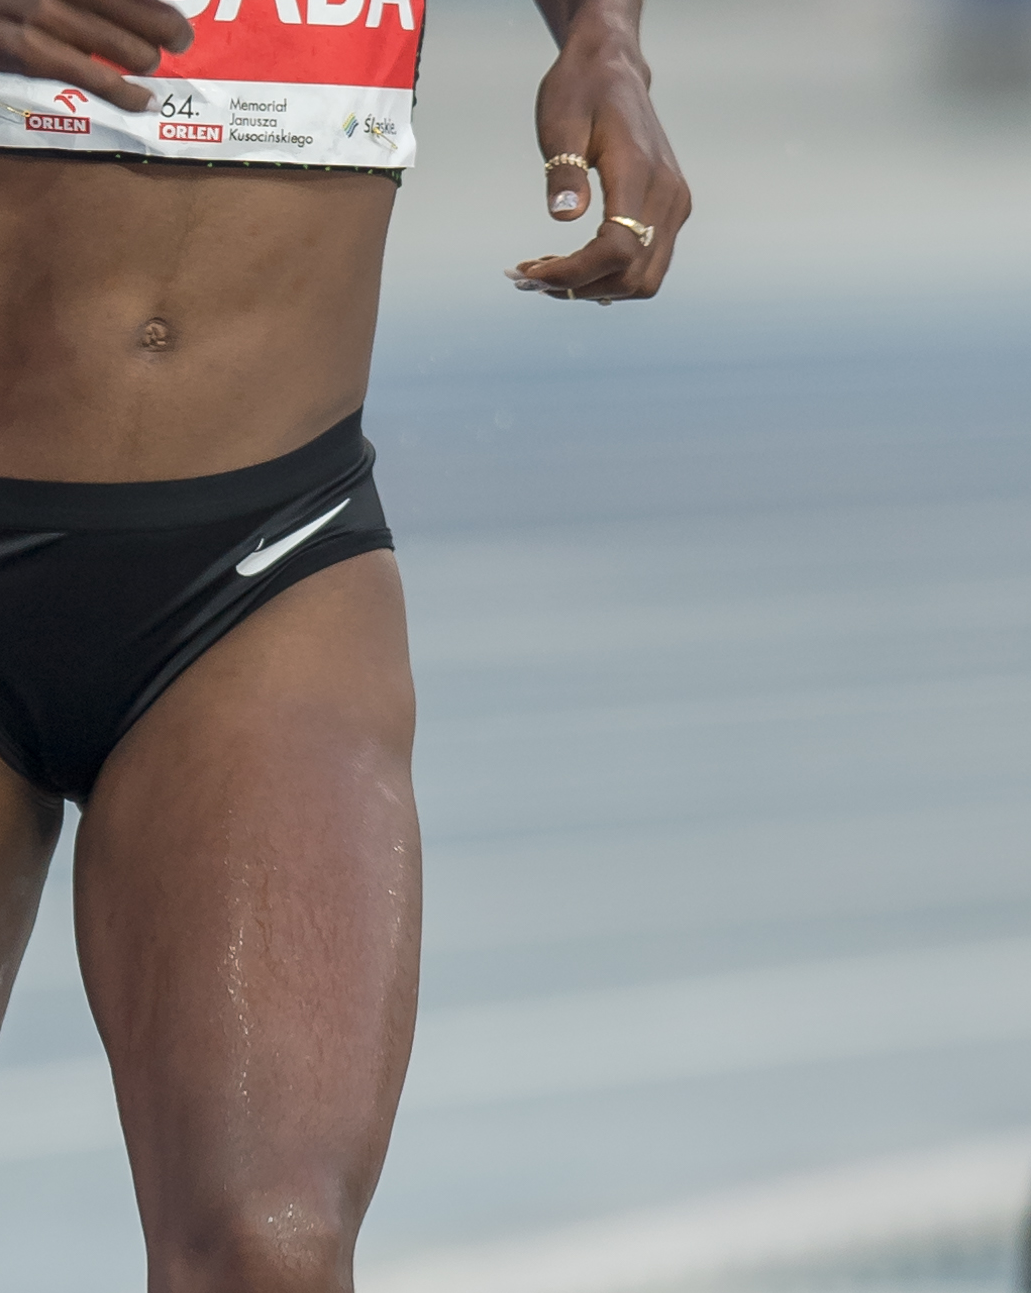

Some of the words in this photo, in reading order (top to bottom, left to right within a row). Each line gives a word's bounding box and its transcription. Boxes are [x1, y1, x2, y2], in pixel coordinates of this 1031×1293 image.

[160, 93, 200, 119] 64.
[229, 97, 288, 113] Memoriał
[28, 116, 86, 132] ORLEN
[229, 113, 278, 128] Janusza
[161, 124, 221, 141] ORLEN
[228, 129, 314, 148] Kusocińskiego
